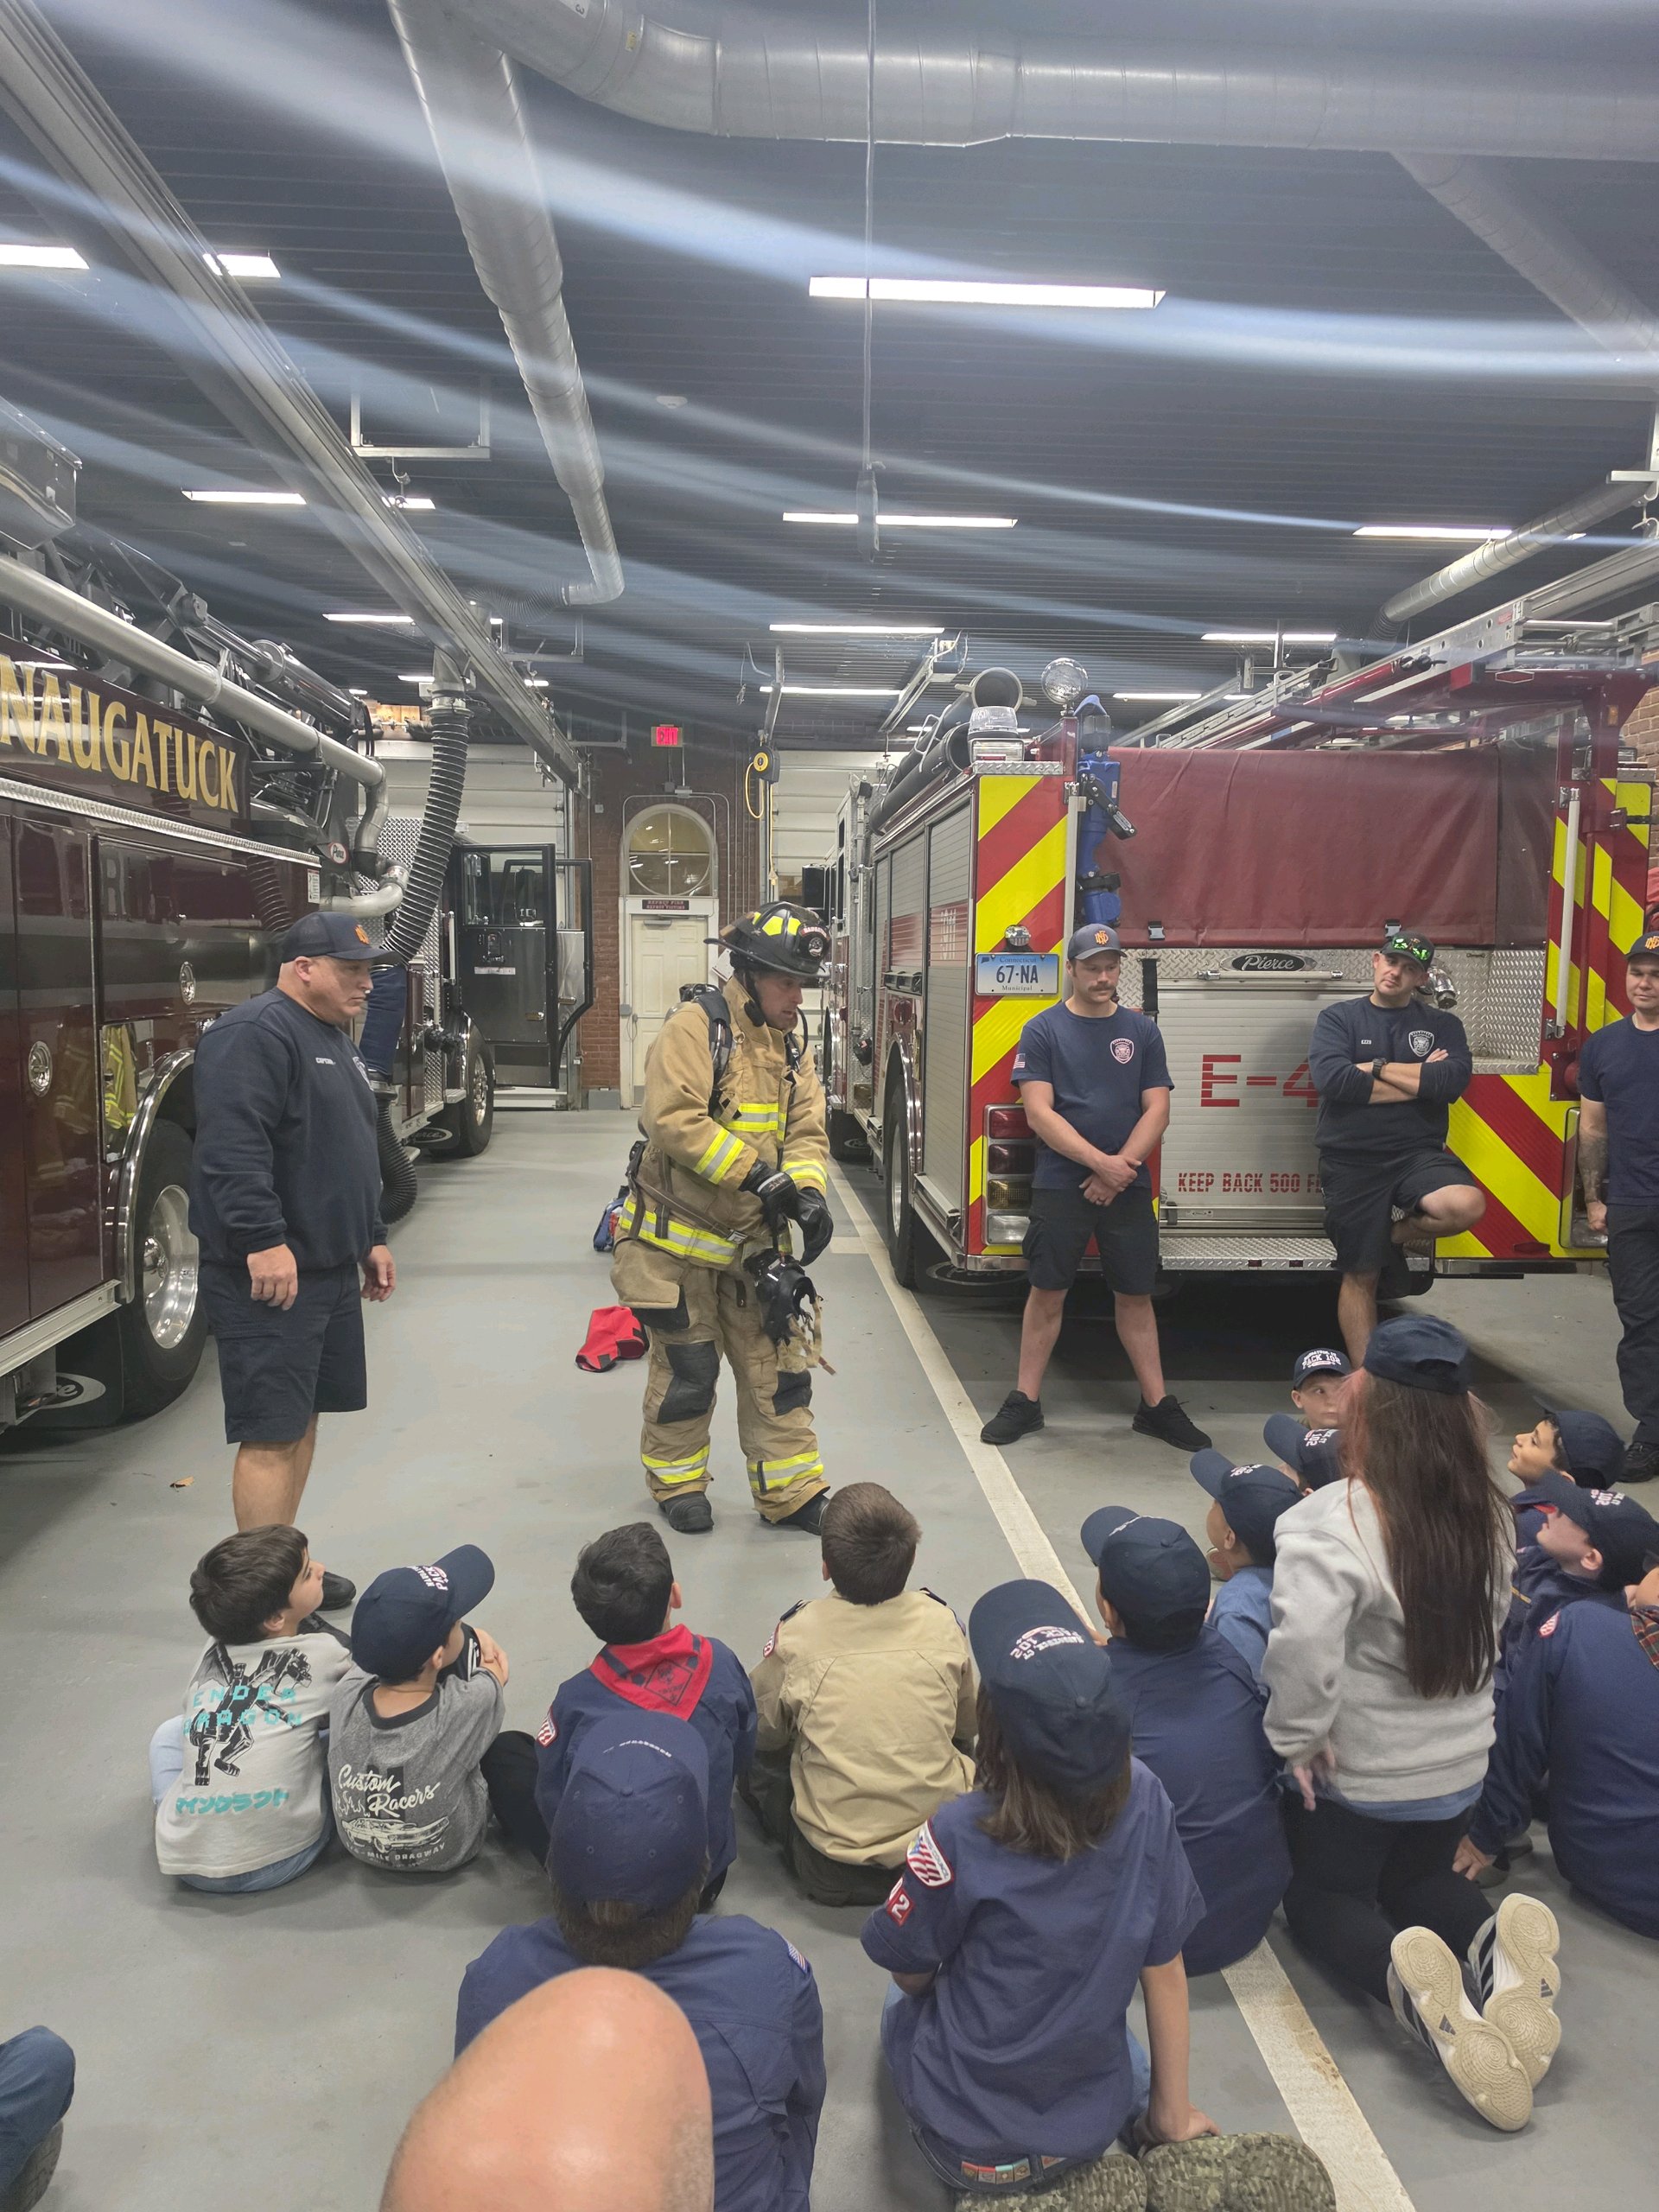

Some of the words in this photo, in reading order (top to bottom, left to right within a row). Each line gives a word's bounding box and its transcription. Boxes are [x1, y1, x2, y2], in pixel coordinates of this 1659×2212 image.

[0, 653, 239, 814] NAUGATUCK
[1241, 954, 1295, 971] Pierce
[1200, 1054, 1319, 1108] E-4
[1178, 1173, 1215, 1192] KEEP
[1222, 1173, 1263, 1192] BACK
[1269, 1173, 1300, 1192] 500
[1302, 1354, 1323, 1370] PACK
[1325, 1354, 1342, 1366] 102
[1009, 1637, 1038, 1659] 102
[193, 1684, 297, 1708] ENDER
[182, 1707, 303, 1736] DRAGON
[339, 1764, 402, 1794] Custom
[366, 1781, 442, 1818] Racers
[394, 1841, 445, 1861] DRAGWAY
